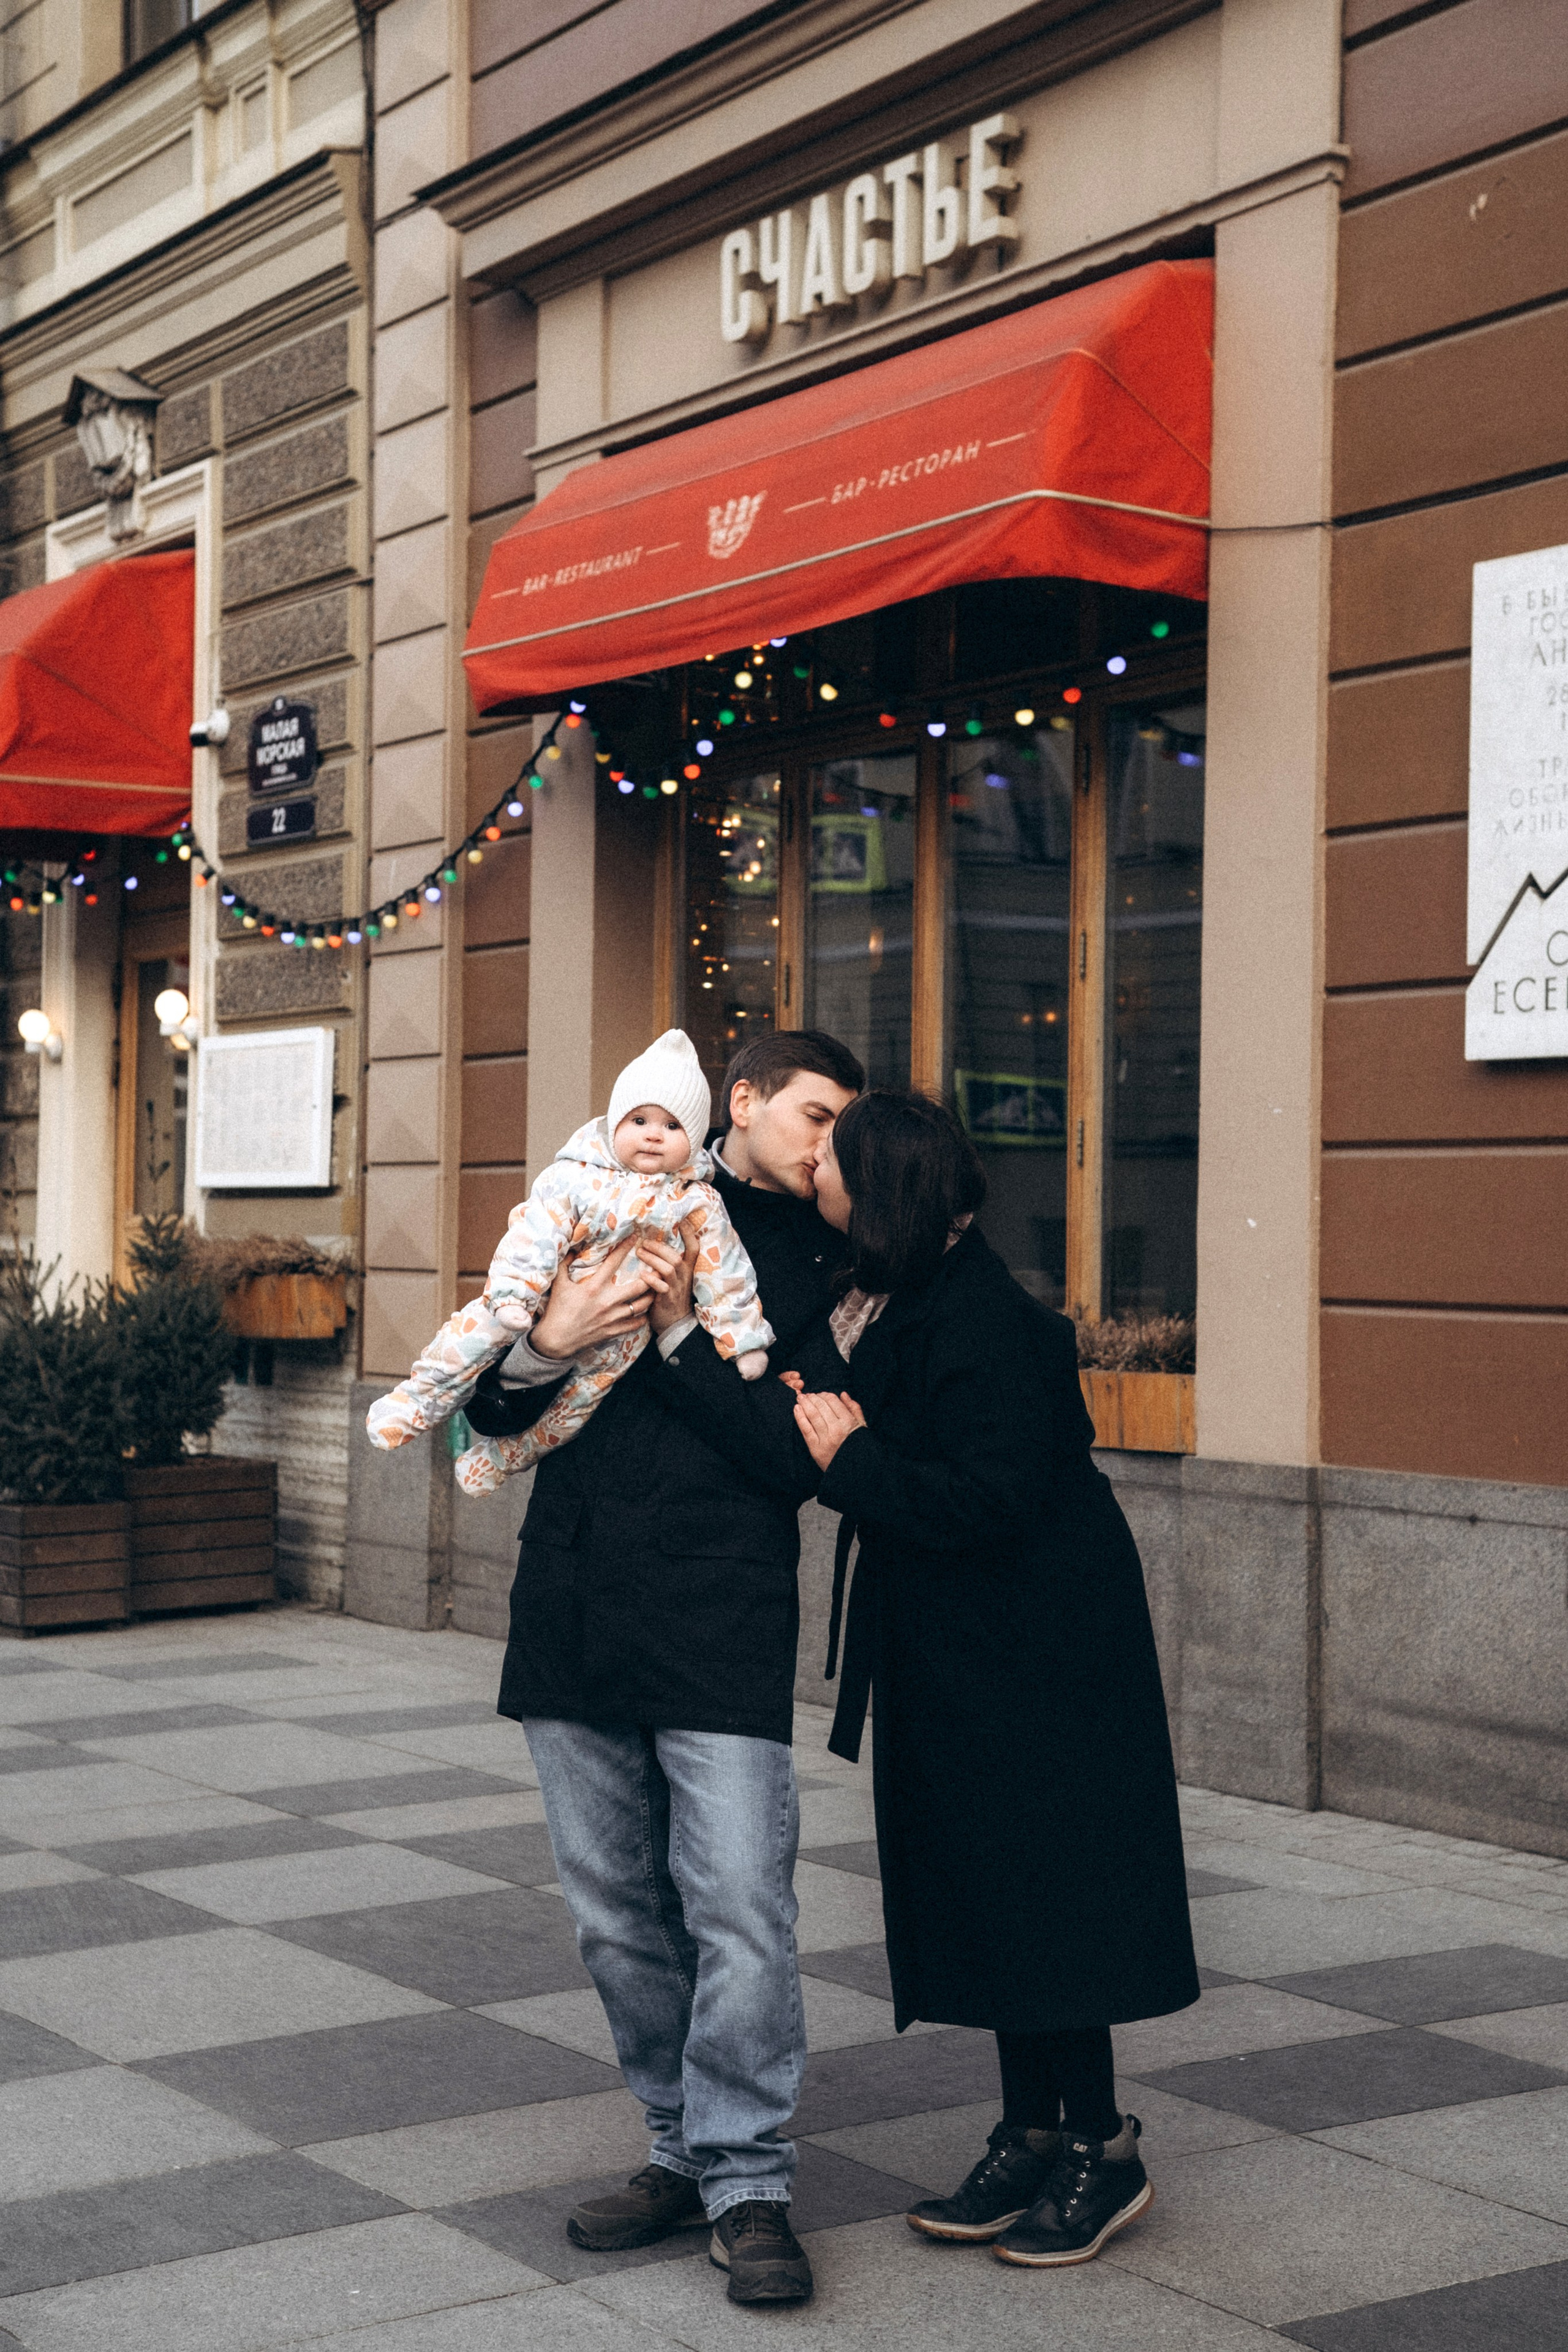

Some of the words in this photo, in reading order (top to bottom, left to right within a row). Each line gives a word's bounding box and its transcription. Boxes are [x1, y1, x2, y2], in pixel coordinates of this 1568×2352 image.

[720, 113, 1008, 342] СЧАСТЬЕ
[271, 807, 286, 834] 22
[1493, 976, 1568, 1014] ЕСЕ
[1073, 2143, 1088, 2153] CAT
